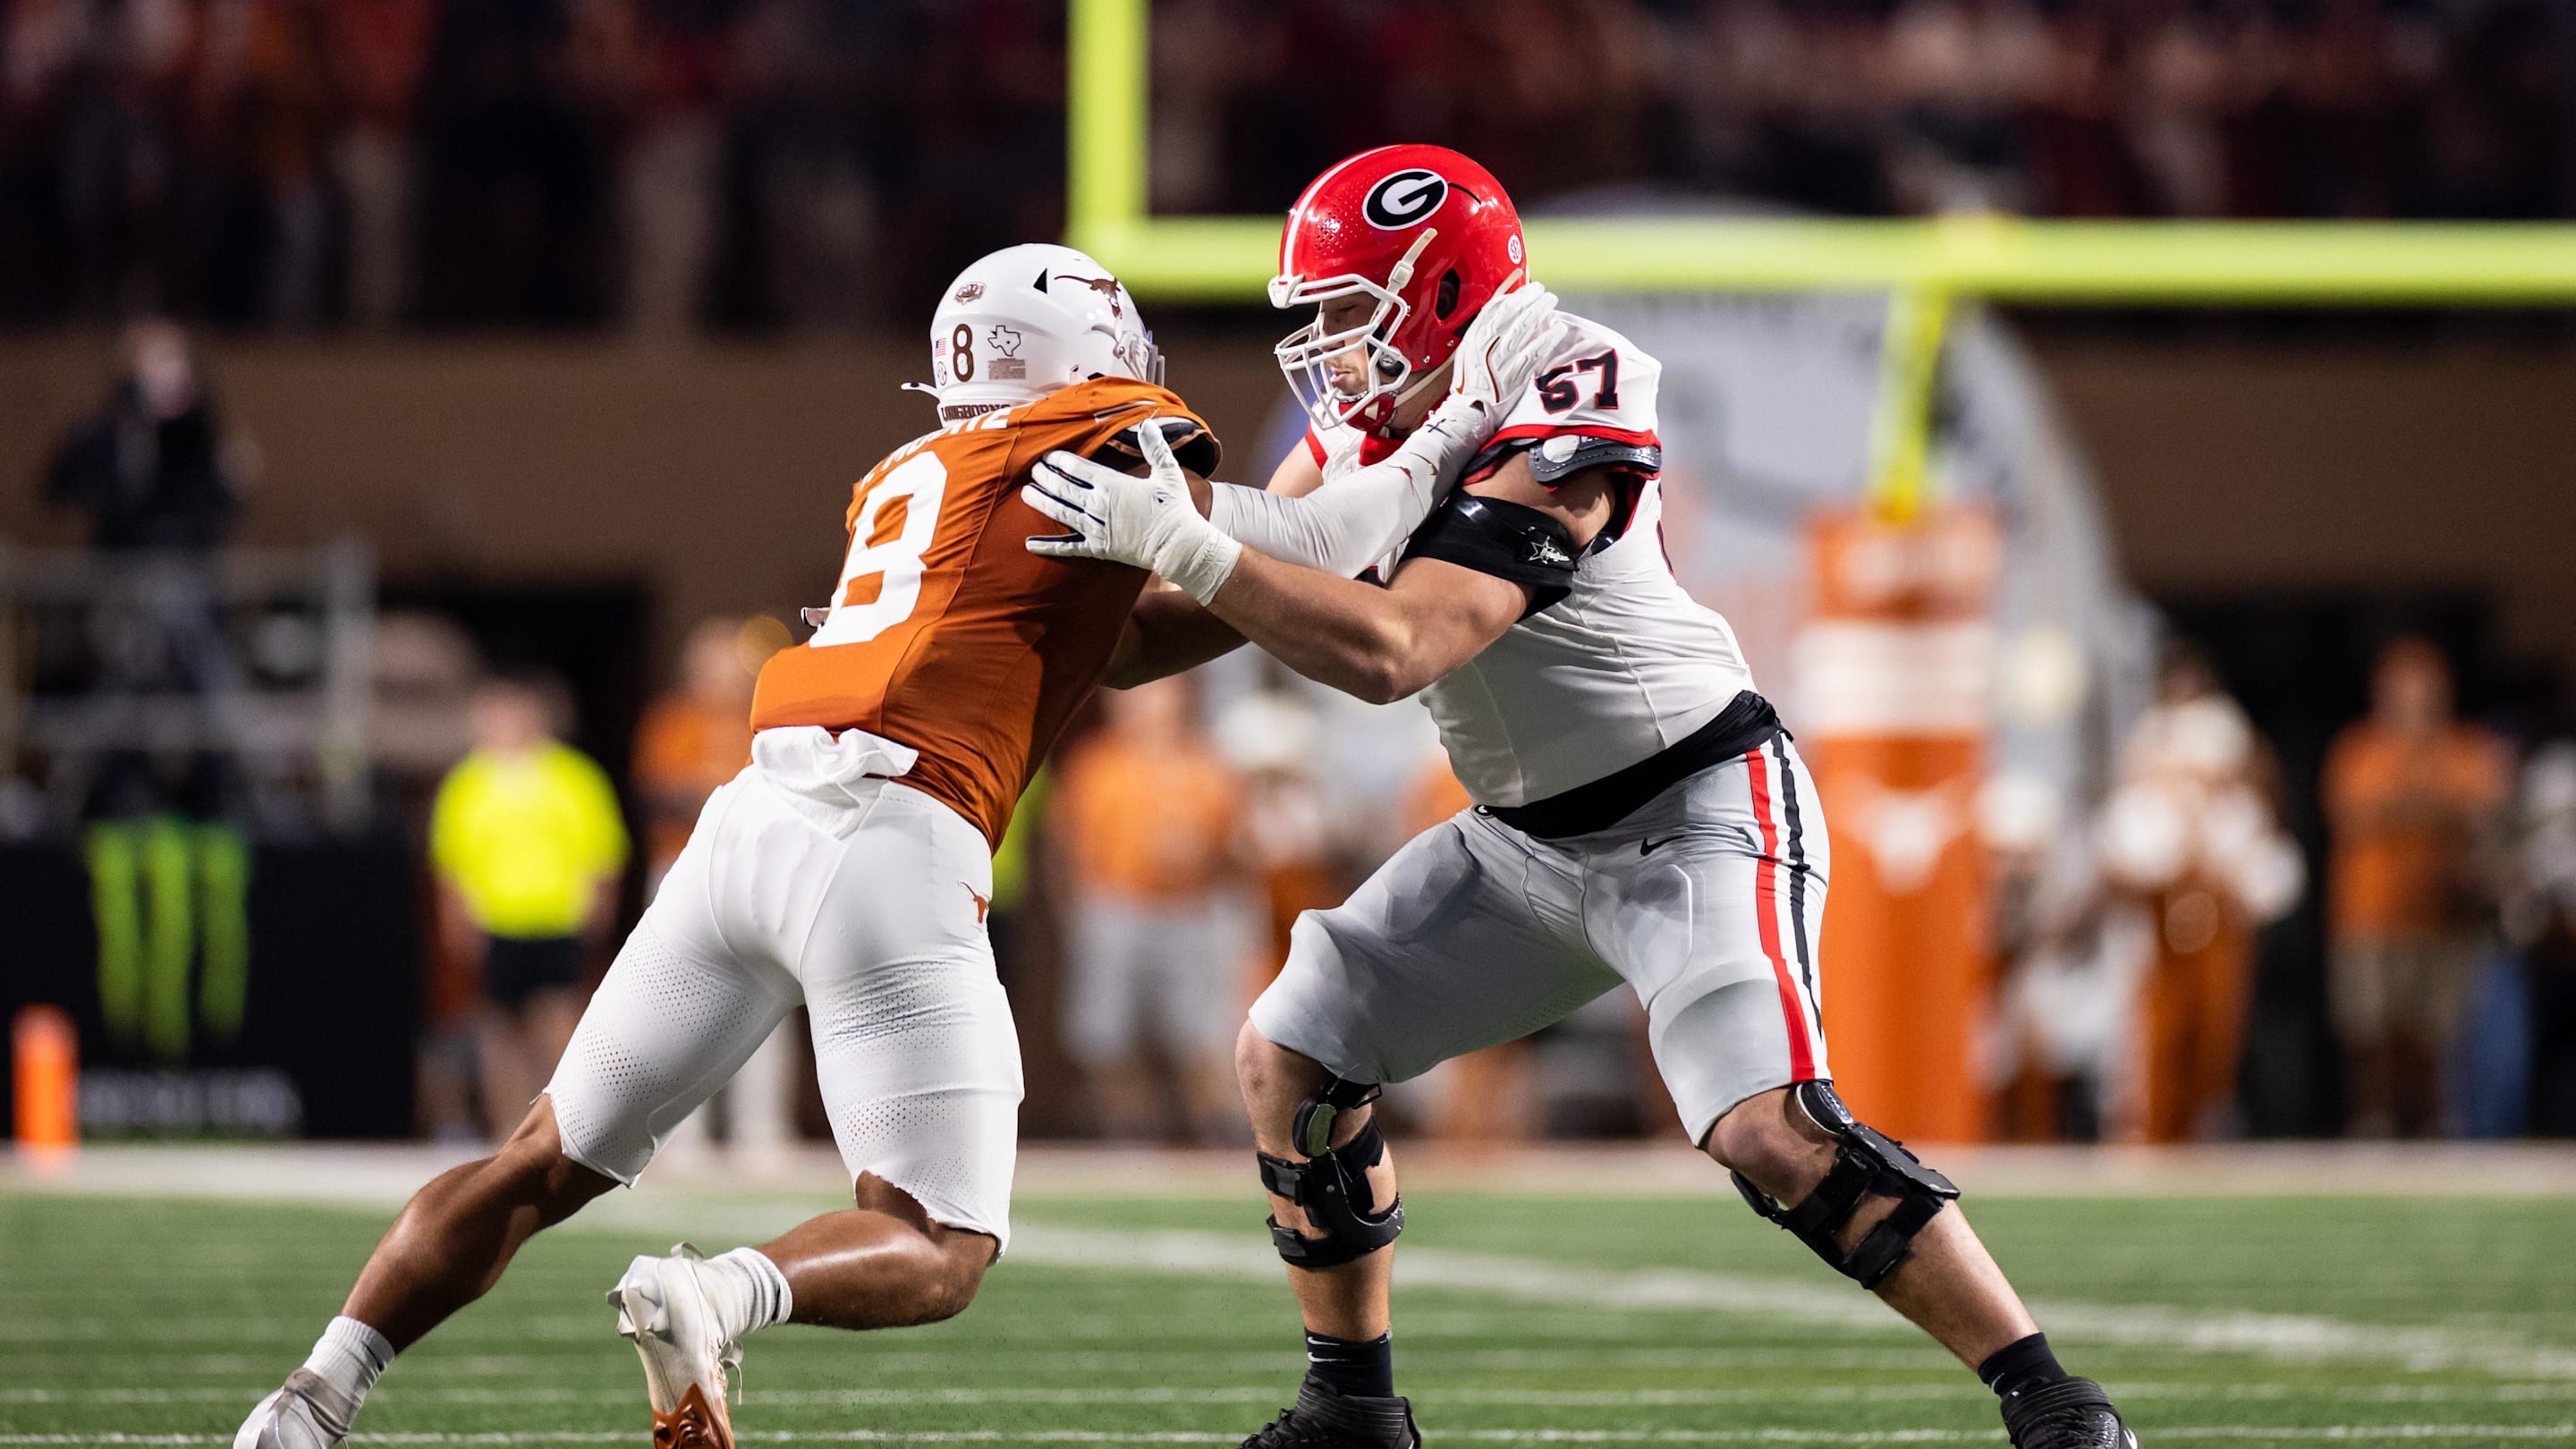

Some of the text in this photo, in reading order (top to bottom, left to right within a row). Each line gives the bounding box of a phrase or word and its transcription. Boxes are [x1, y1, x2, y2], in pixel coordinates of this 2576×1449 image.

[1364, 170, 1446, 228] G
[953, 324, 974, 382] 8
[1534, 348, 1619, 415] 57
[809, 450, 948, 648] 8
